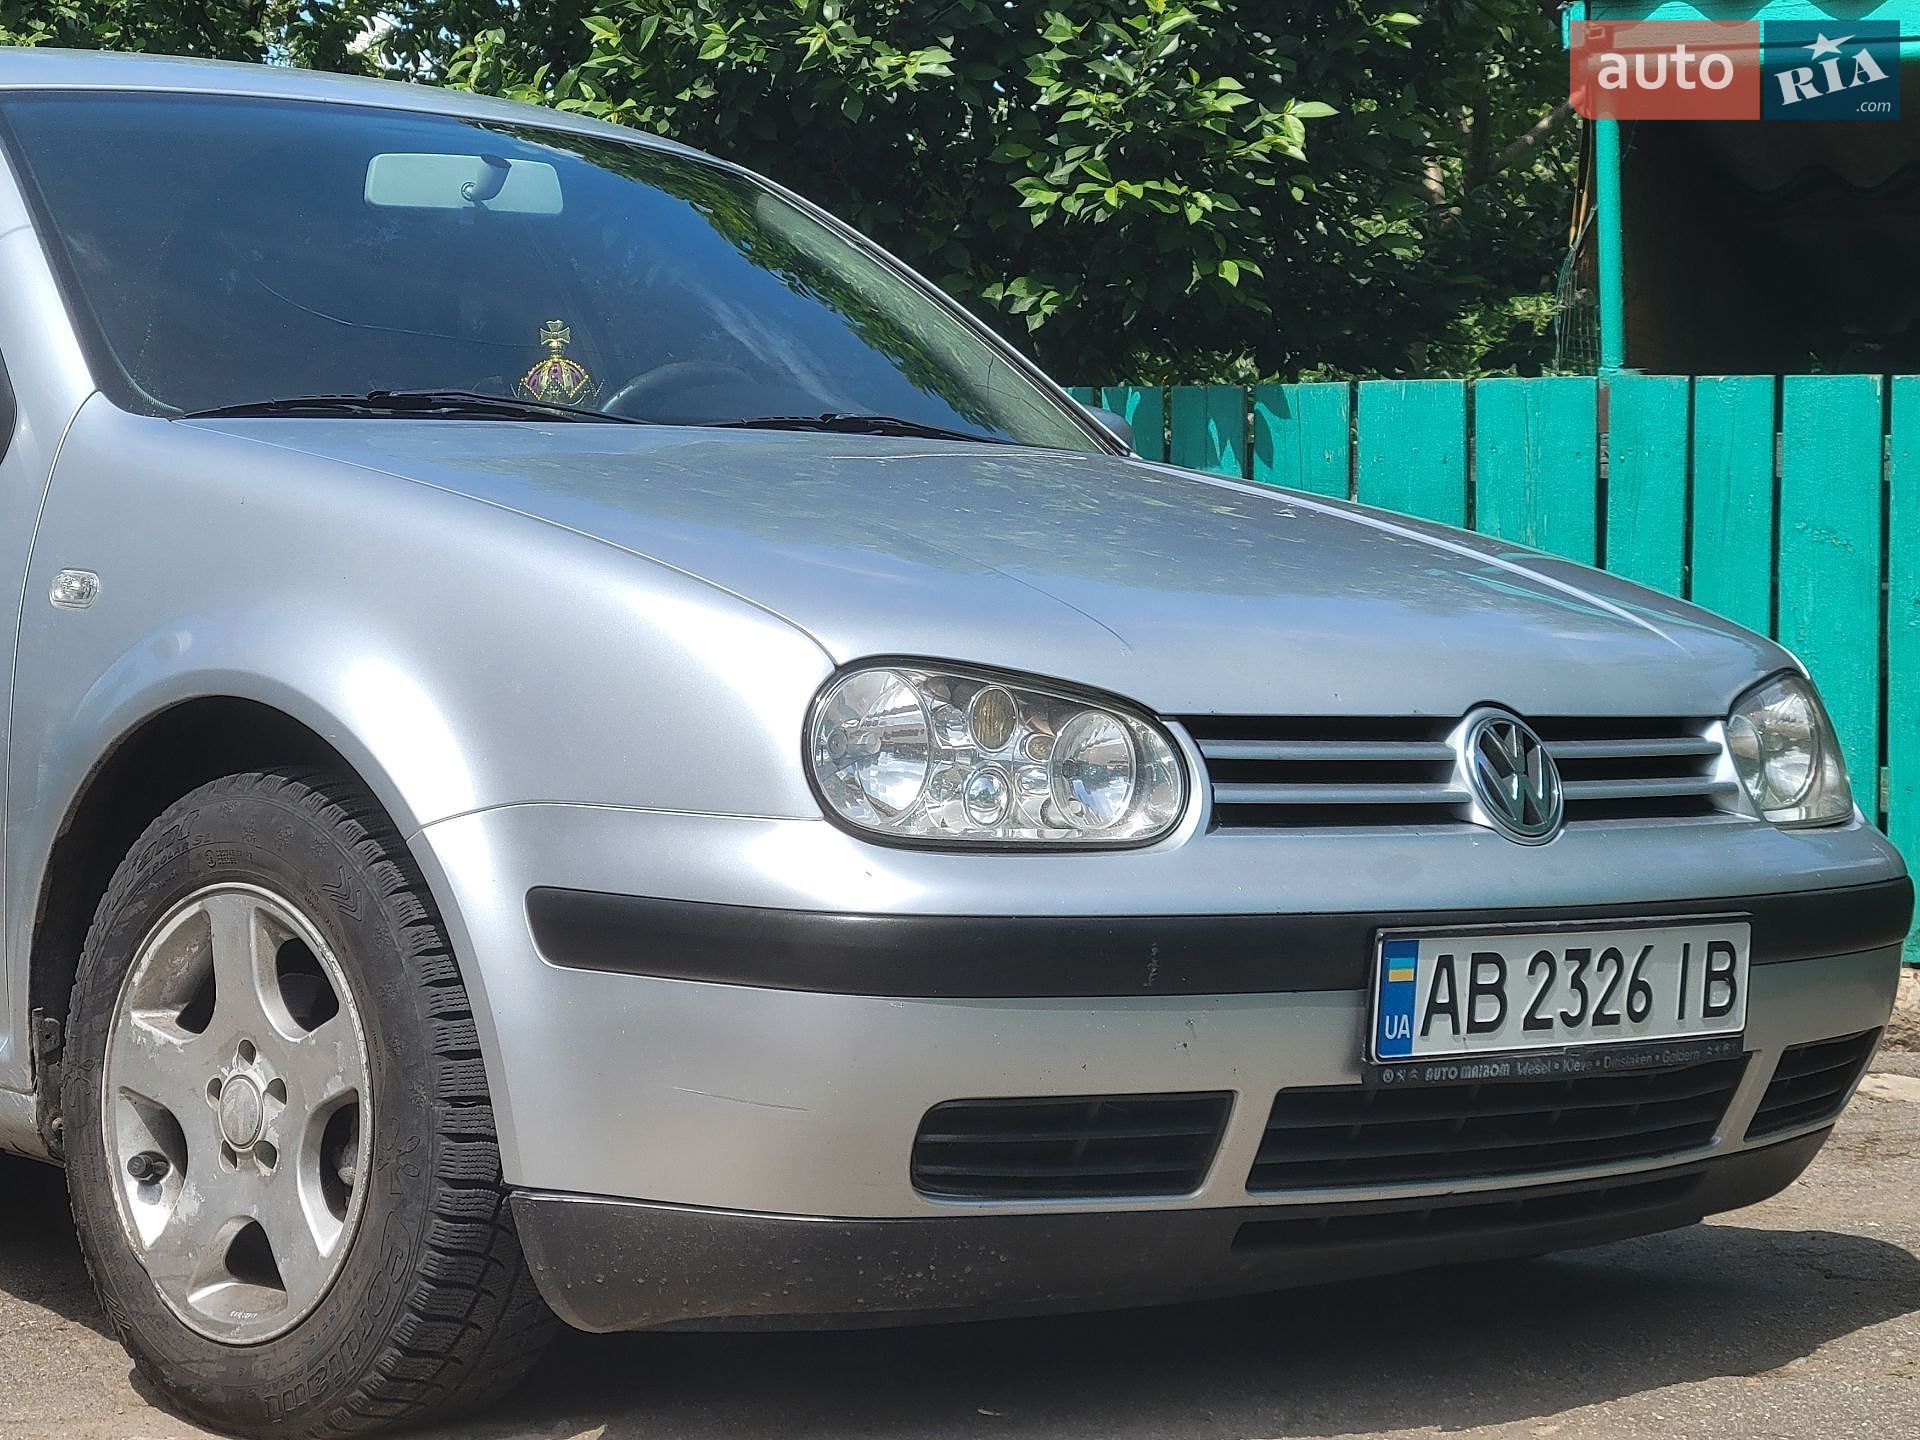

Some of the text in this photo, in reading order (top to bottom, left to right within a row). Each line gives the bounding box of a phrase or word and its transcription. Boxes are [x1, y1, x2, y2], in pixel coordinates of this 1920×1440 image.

[1420, 940, 1738, 1037] AB 2326 IB
[1384, 1015, 1411, 1040] UA
[1425, 1066, 1457, 1081] AUTO
